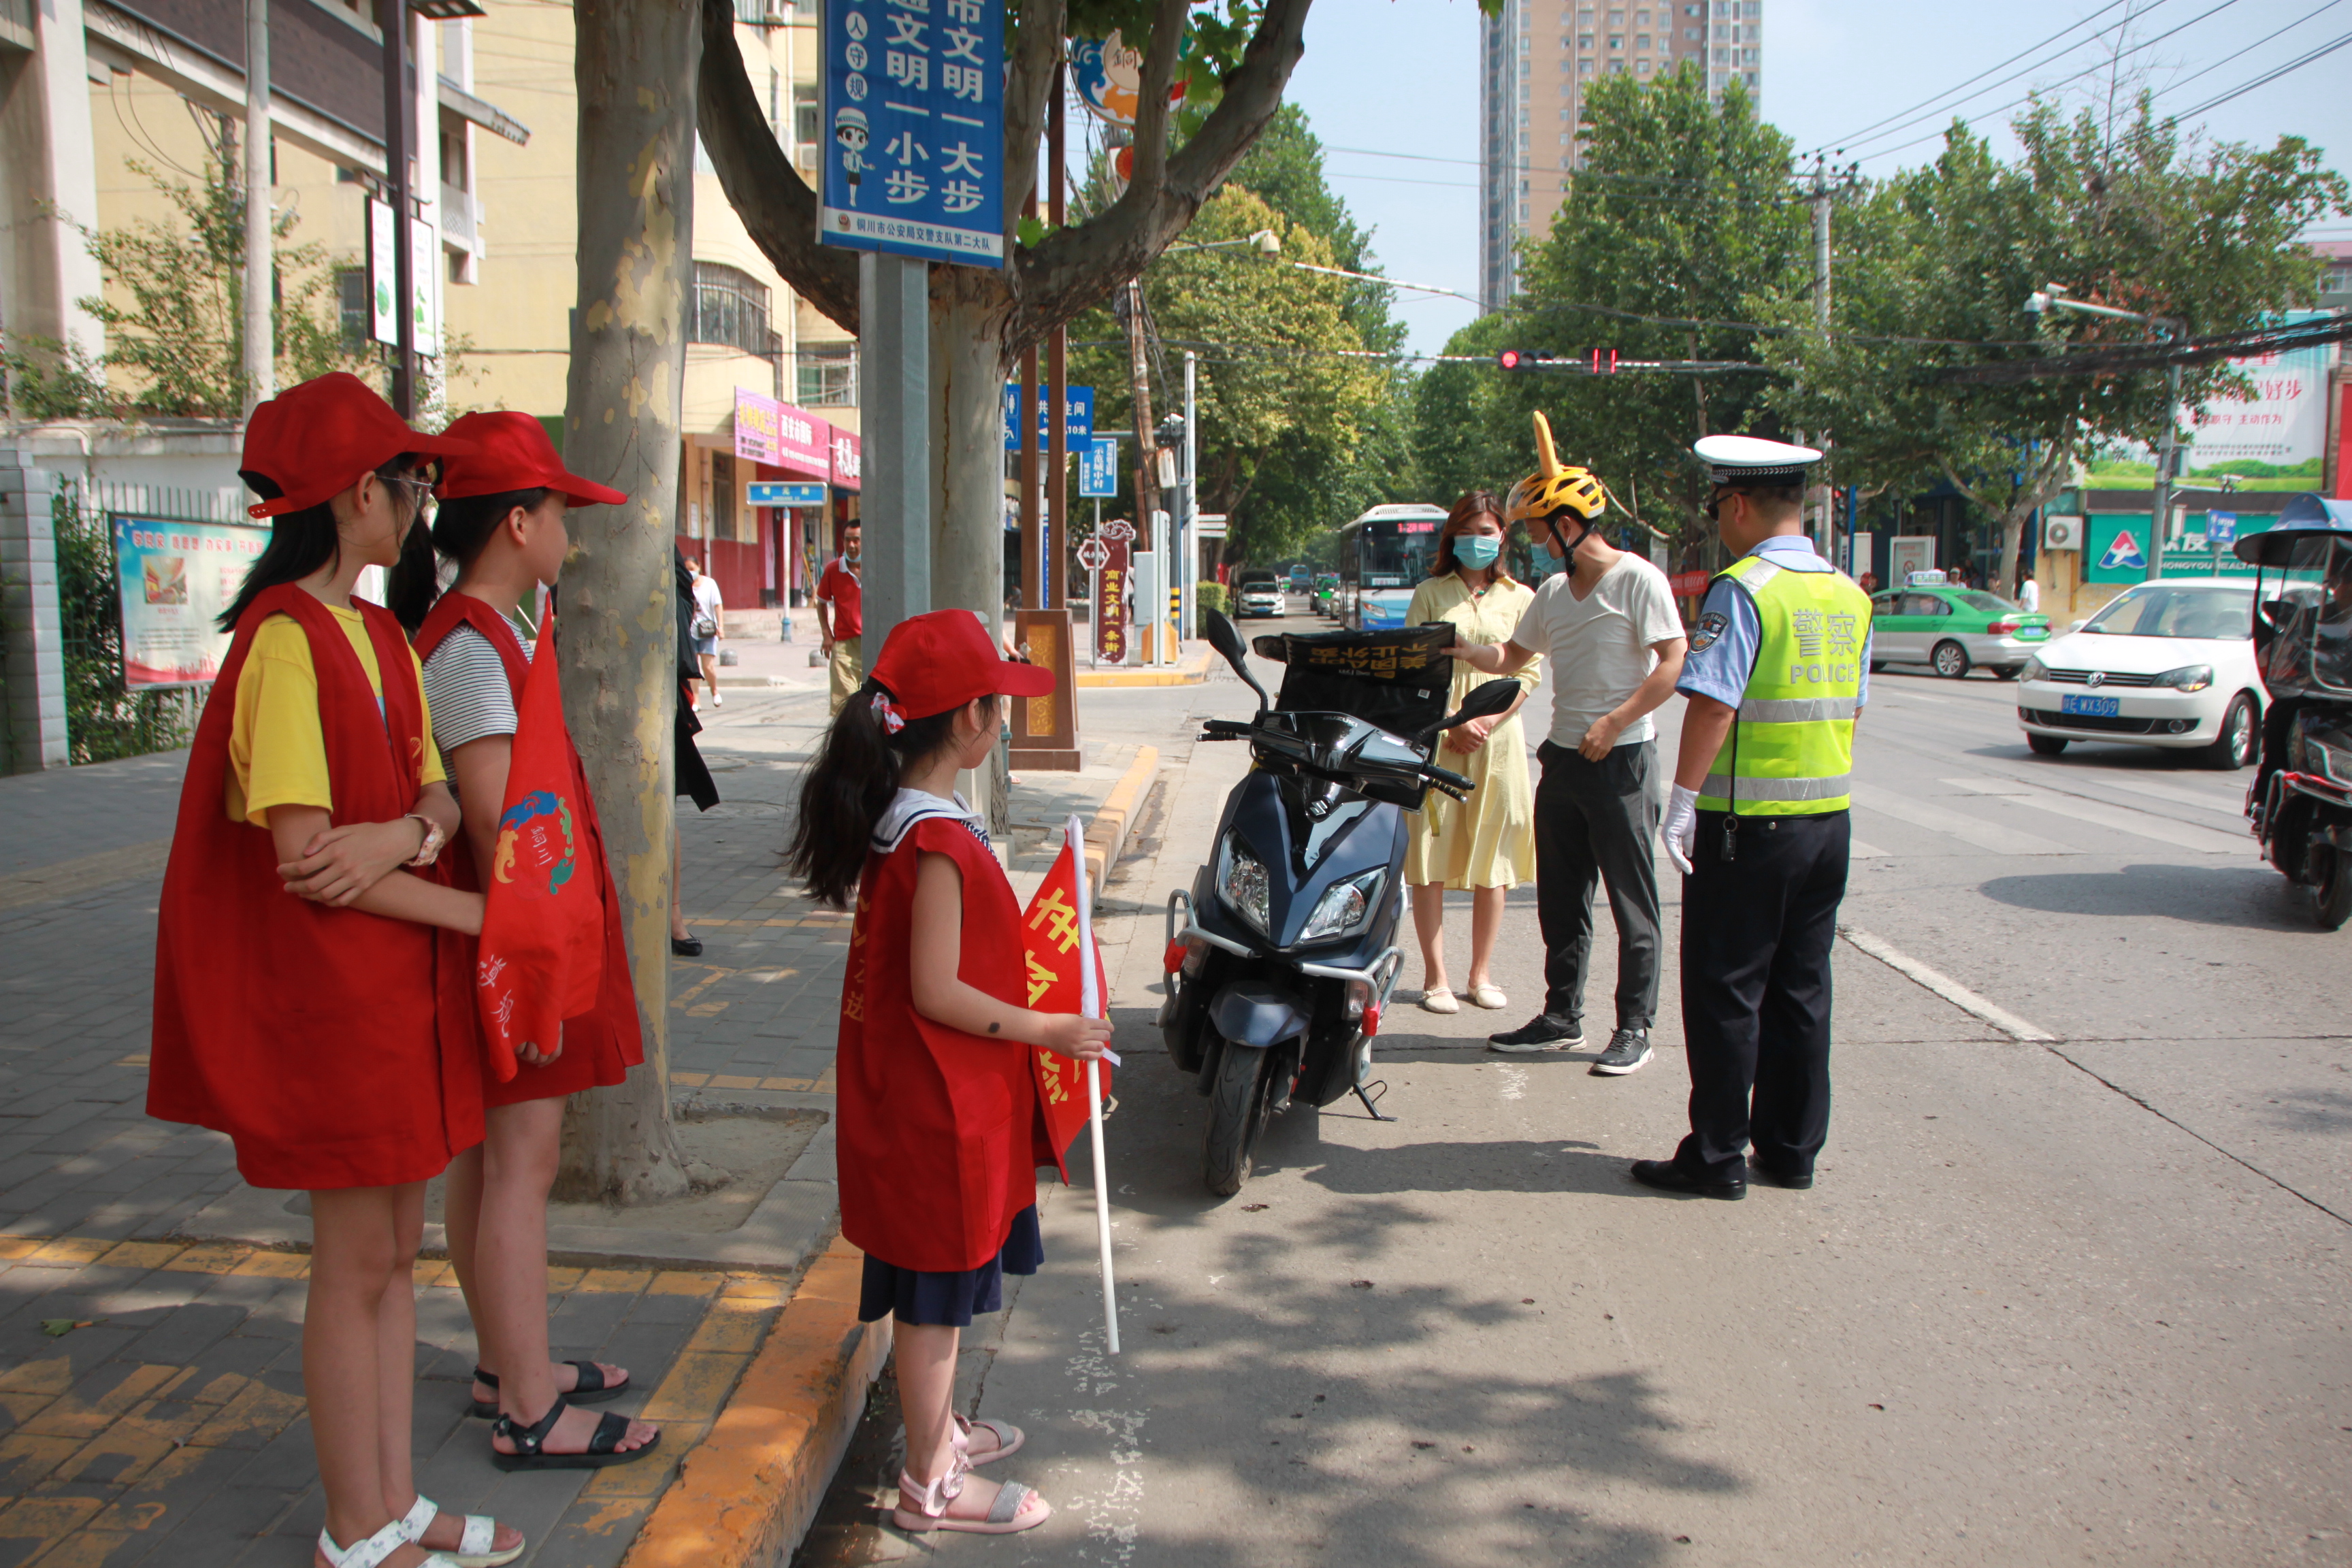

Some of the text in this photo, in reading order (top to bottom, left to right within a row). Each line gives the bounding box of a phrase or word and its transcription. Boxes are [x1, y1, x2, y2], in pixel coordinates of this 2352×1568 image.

[856, 217, 991, 251] 铜川市公安局交警支队第二大队
[2238, 414, 2283, 426] 主动作为
[1104, 570, 1120, 653] 商业文明一条街
[1793, 608, 1857, 657] 警察
[1311, 643, 1429, 658] 不止外卖
[1790, 663, 1855, 684] POLICE
[1323, 715, 1358, 728] SUZUKI
